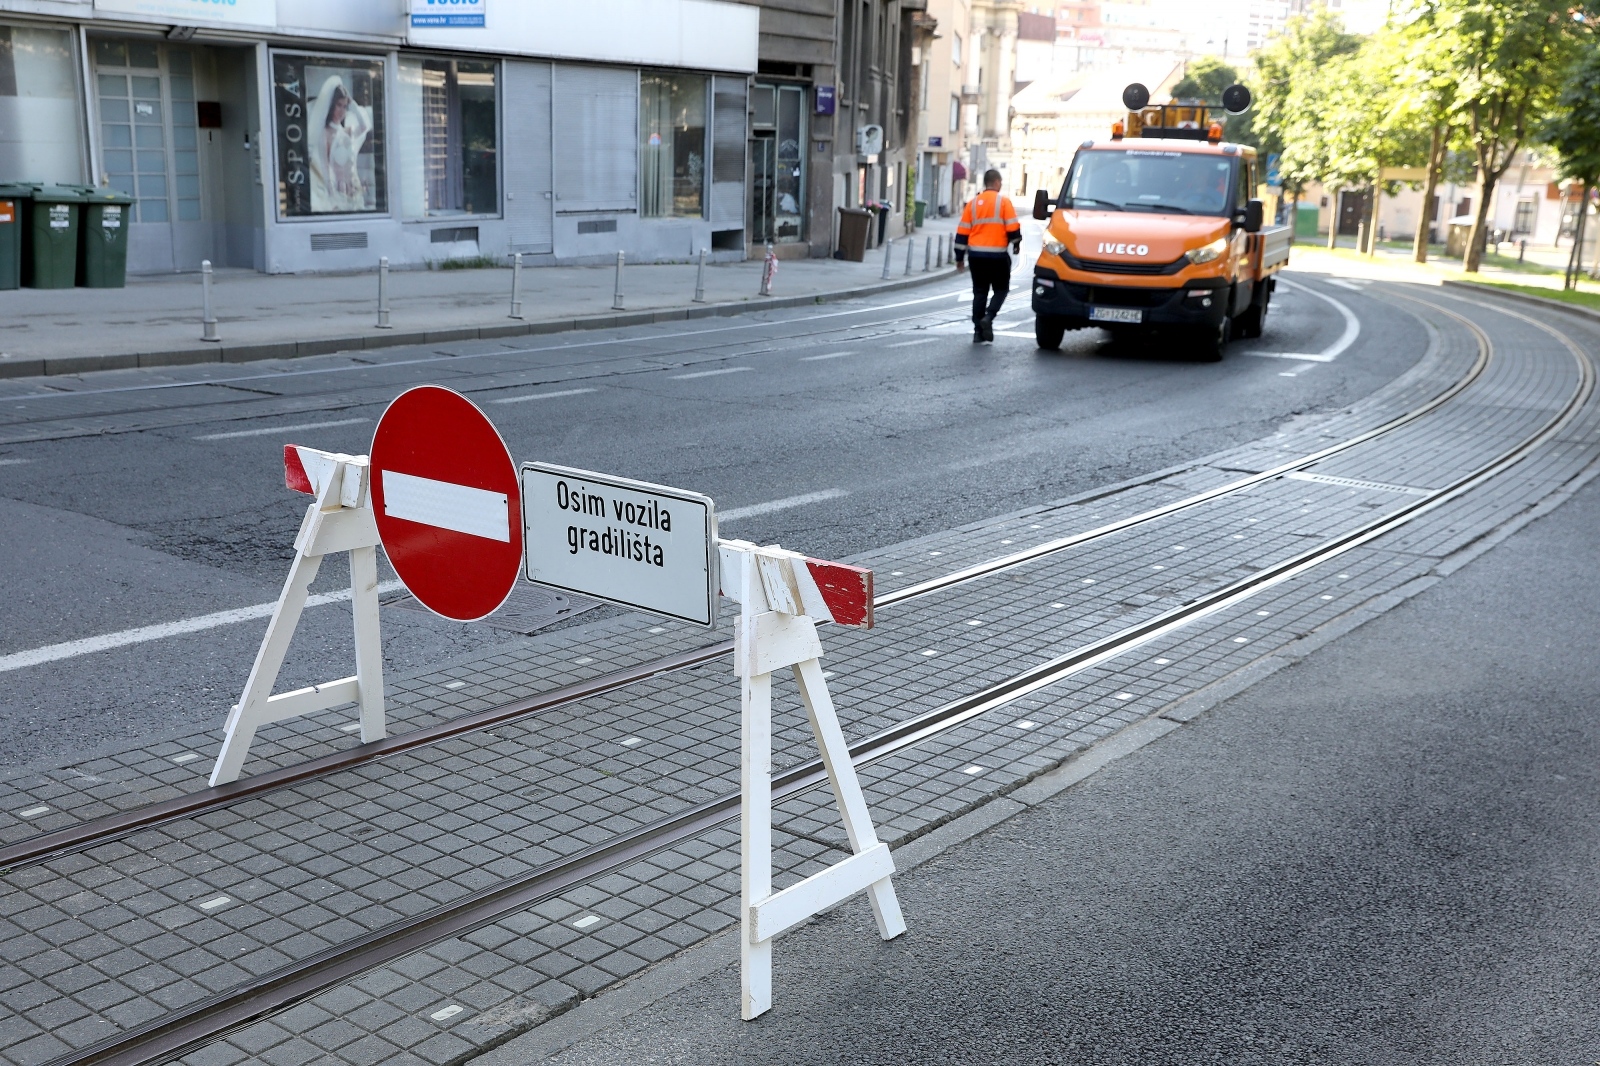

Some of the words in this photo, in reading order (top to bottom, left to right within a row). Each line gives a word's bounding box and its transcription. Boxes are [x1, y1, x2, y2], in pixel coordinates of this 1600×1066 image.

[1097, 242, 1149, 256] IVECO
[556, 480, 606, 518] Osim
[612, 499, 671, 532] vozila
[567, 525, 664, 568] gradilišta
